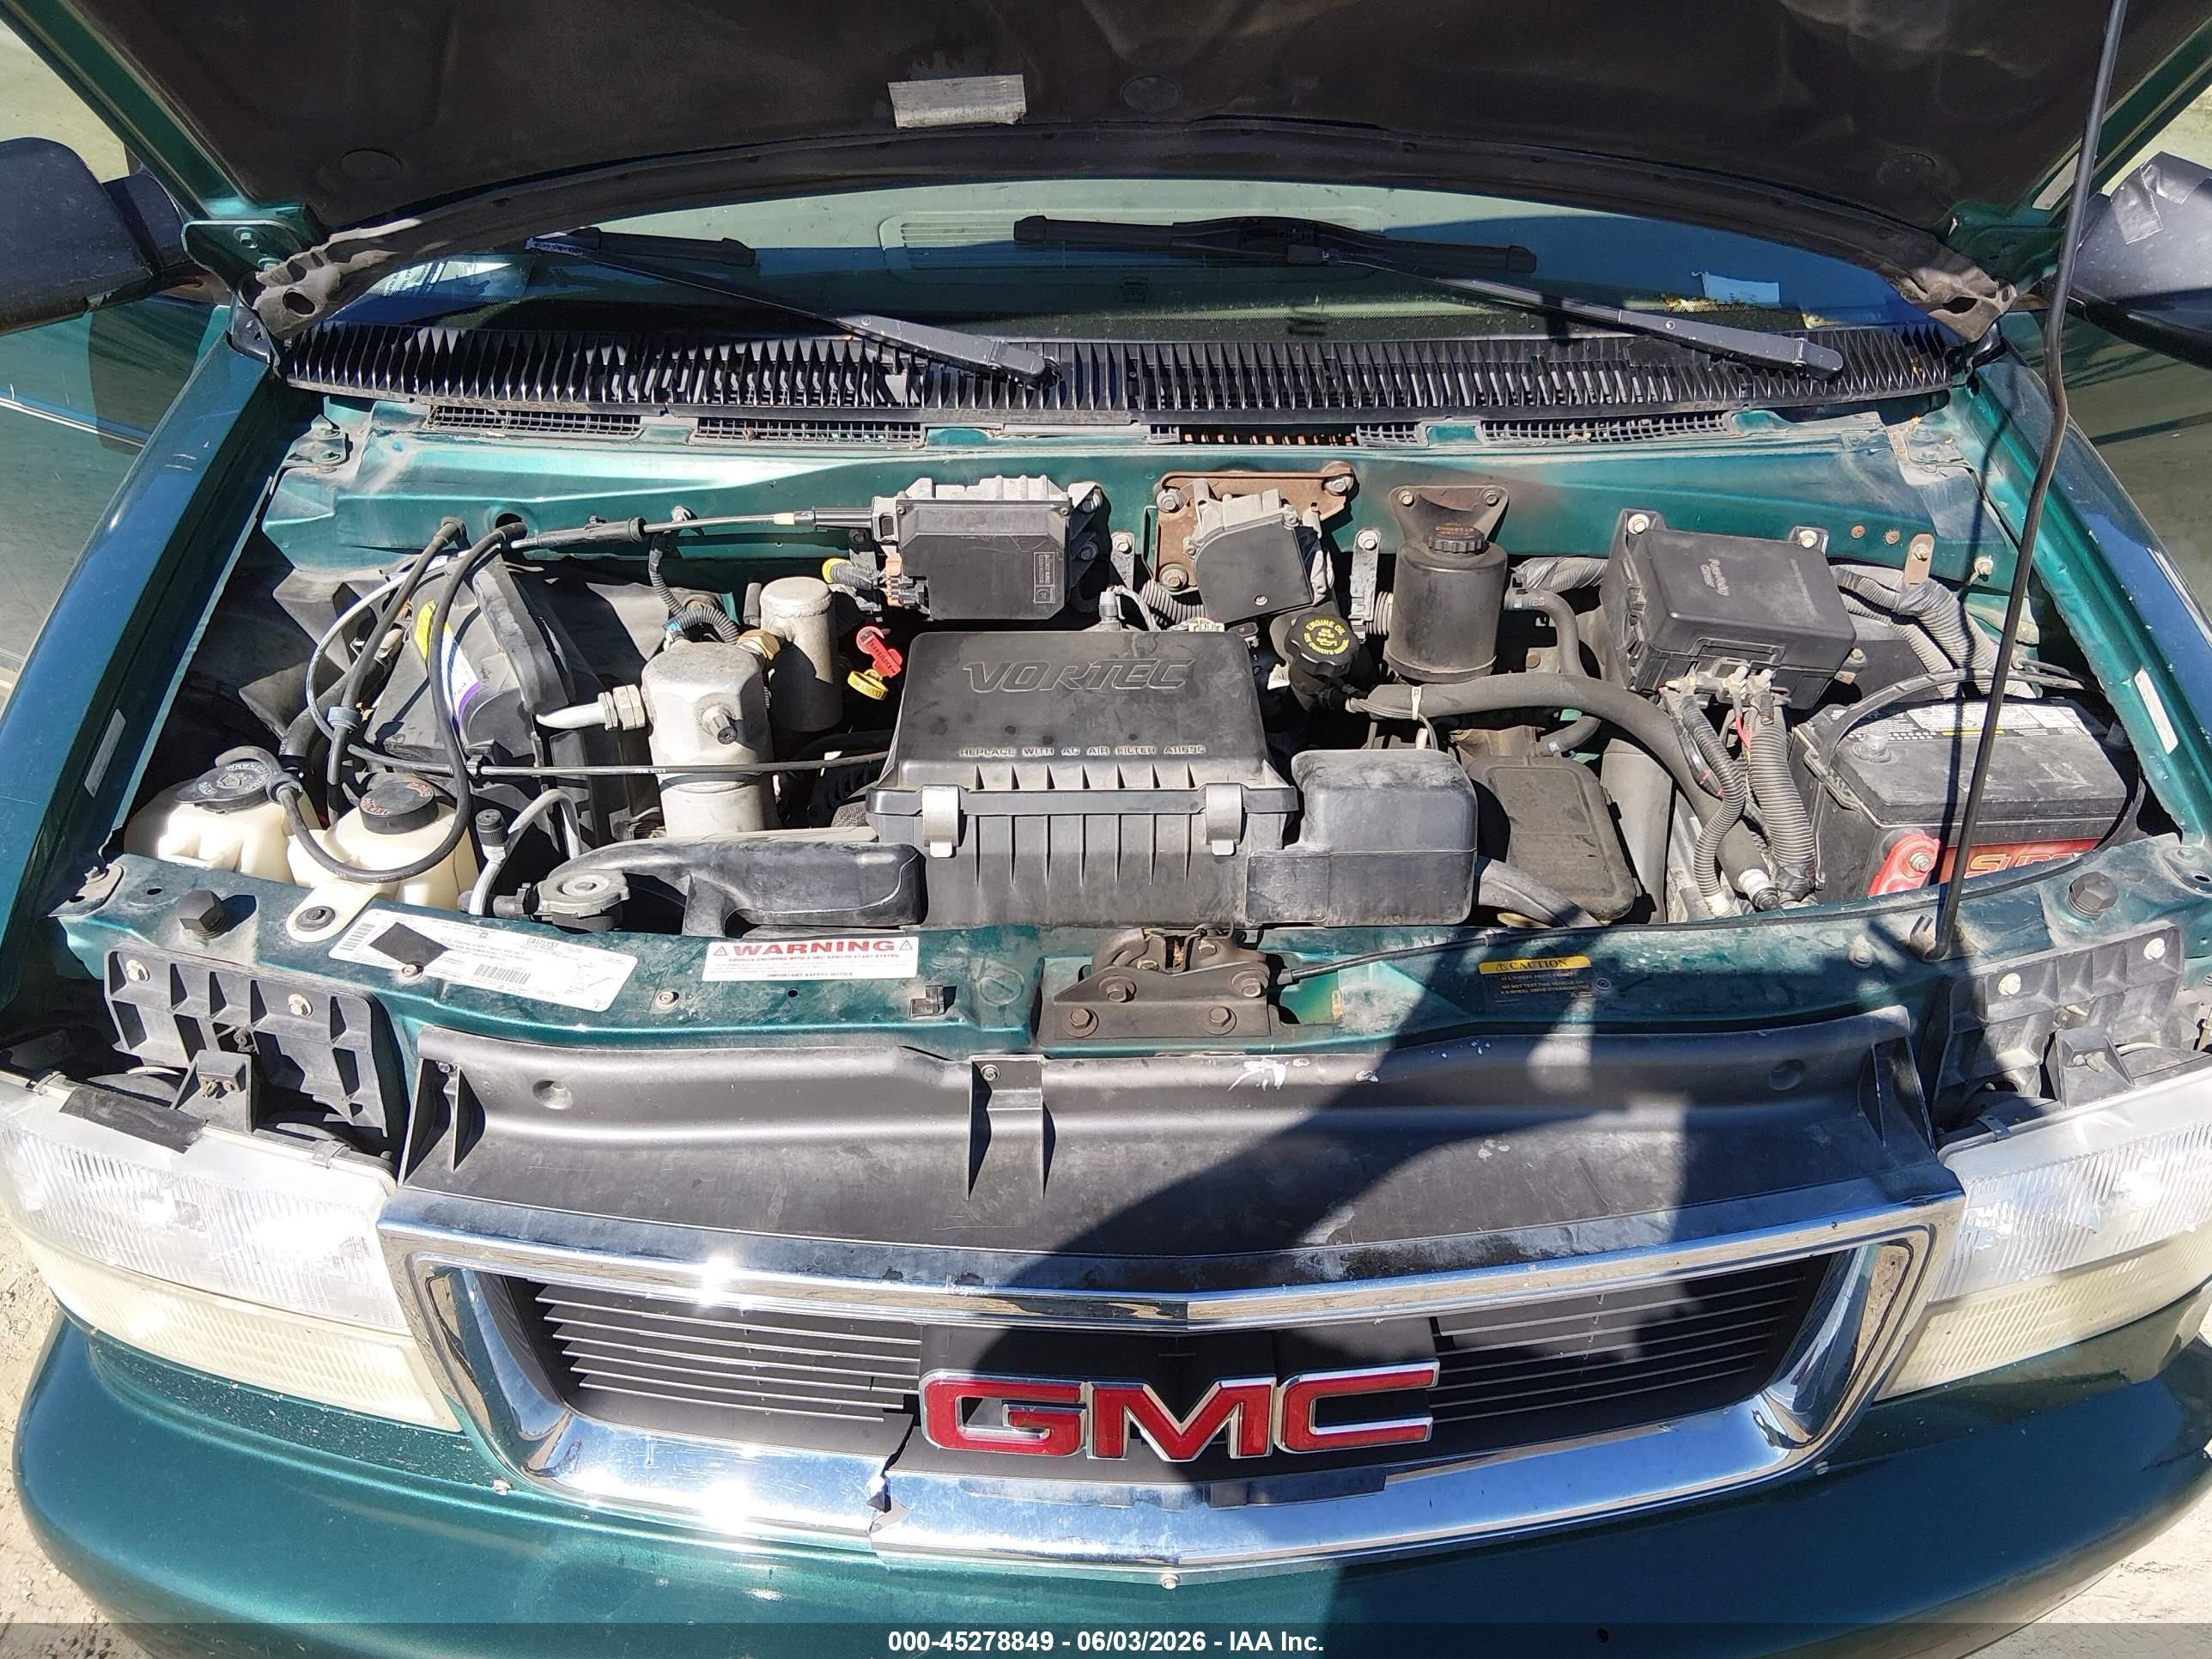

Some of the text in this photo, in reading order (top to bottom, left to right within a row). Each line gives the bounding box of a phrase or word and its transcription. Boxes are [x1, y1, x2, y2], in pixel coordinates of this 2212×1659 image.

[1305, 619, 1346, 635] ENGINE OIL
[963, 658, 1195, 693] VORTEC
[960, 748, 1017, 758] REPLACE
[1022, 747, 1054, 757] WITH
[1086, 746, 1110, 756] AIR
[1115, 745, 1156, 756] FILTER
[732, 940, 896, 957] WARNING
[1509, 958, 1569, 970] CAUTION
[920, 1362, 1440, 1462] GMC
